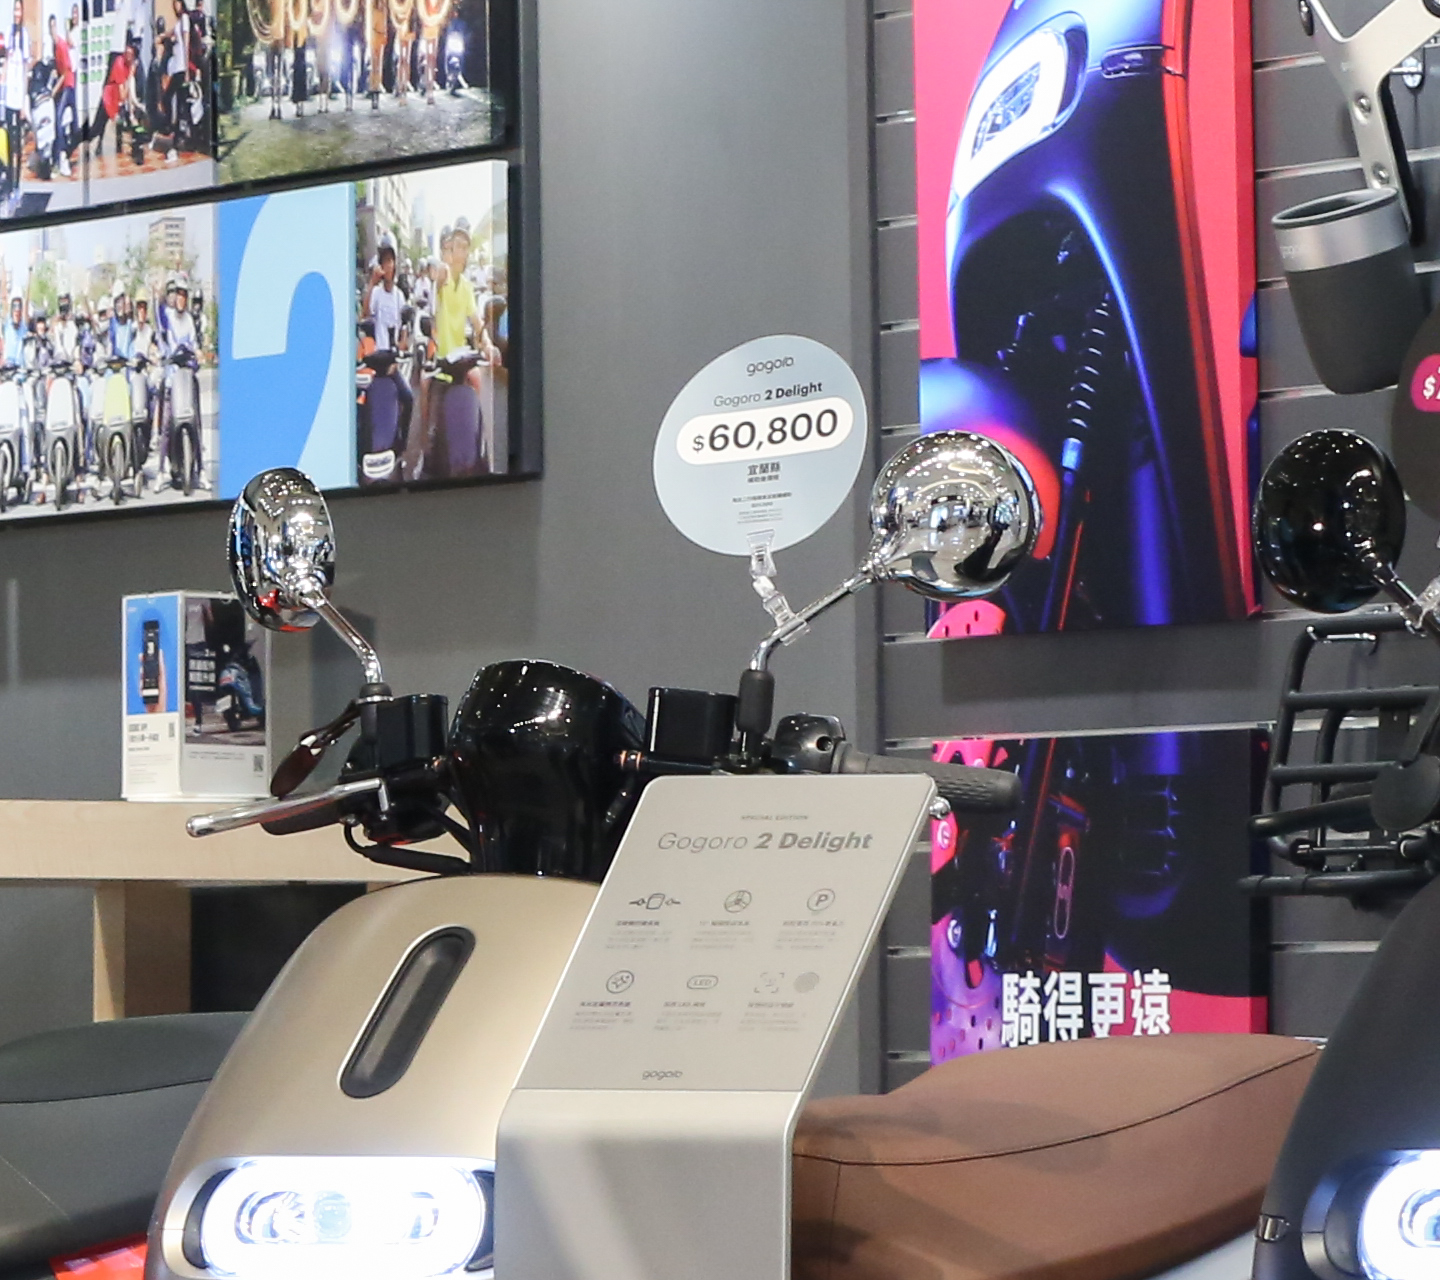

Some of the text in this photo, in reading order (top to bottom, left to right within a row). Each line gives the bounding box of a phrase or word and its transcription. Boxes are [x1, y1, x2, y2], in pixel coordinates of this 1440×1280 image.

[746, 355, 795, 377] gogoro
[714, 382, 823, 408] Gogoro 2 Delight
[692, 408, 838, 454] $60,800
[657, 831, 874, 855] Gogoro 2 Delight
[1000, 968, 1172, 1048] 騎得更遠
[641, 1069, 684, 1081] gogoro
